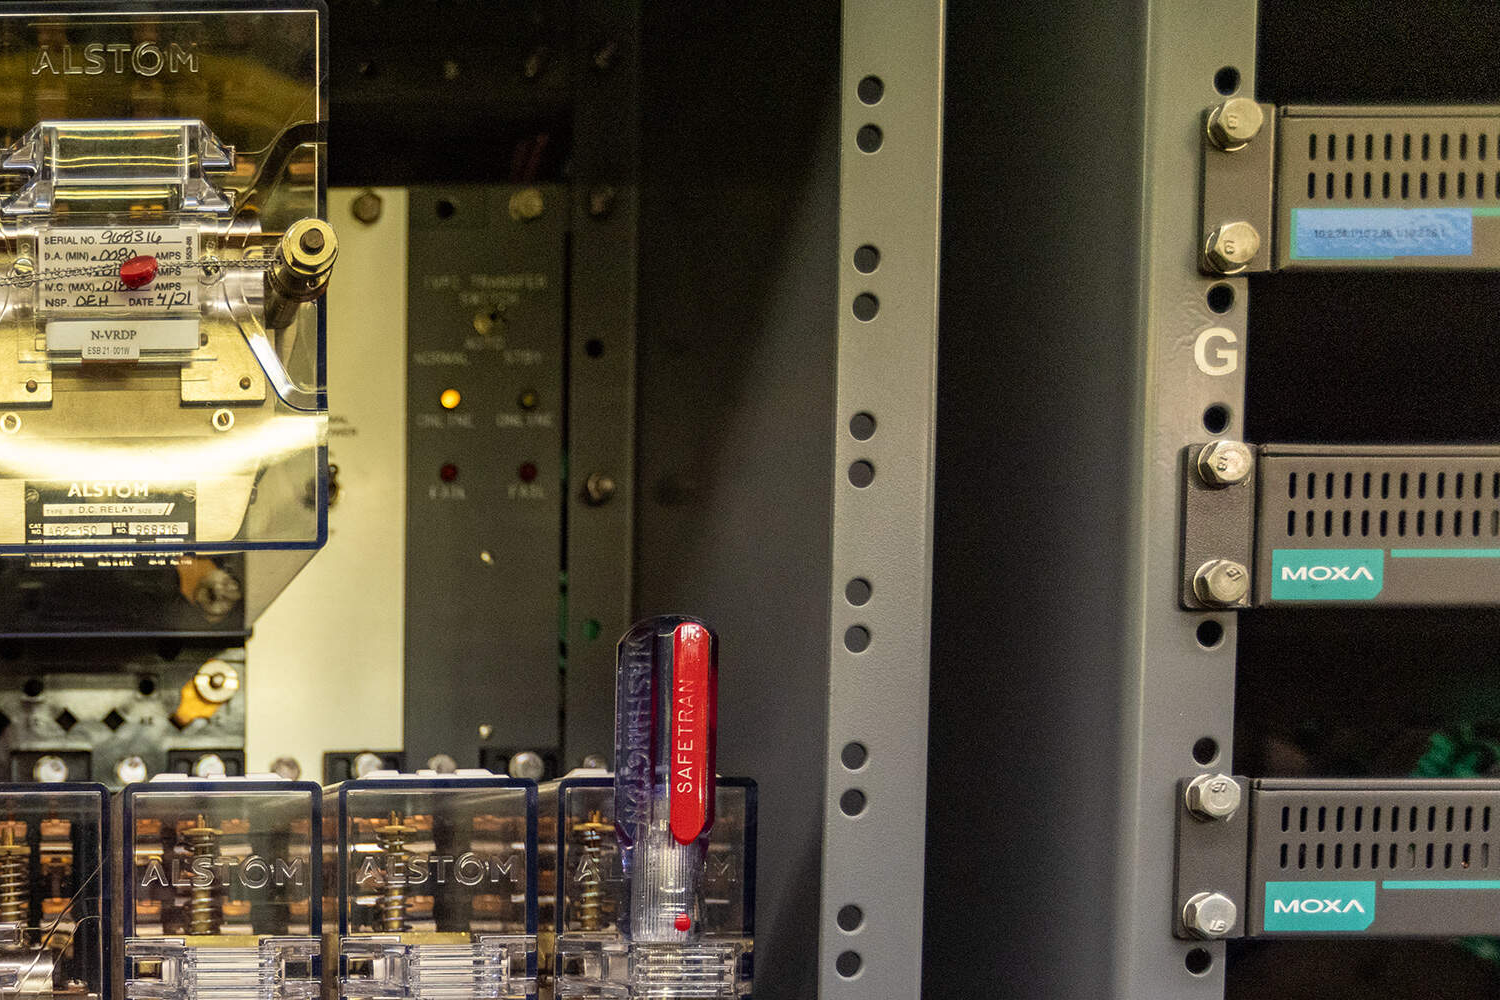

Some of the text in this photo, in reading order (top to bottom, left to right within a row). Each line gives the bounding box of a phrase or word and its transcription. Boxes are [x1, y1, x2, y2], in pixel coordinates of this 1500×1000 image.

[30, 41, 200, 78] ALSTOM
[44, 230, 163, 245] SERIAL NO. 968316
[65, 252, 89, 261] (MIN)
[154, 251, 181, 260] AMPS
[154, 282, 181, 291] AMPS
[128, 298, 154, 307] DATE
[91, 330, 137, 340] N-VRDP
[1194, 327, 1239, 376] G
[67, 482, 149, 498] ALSTOM
[100, 506, 135, 514] RELAY
[1281, 566, 1373, 581] MOXA
[676, 679, 695, 794] SAFETRAN
[139, 853, 305, 890] ALSTOM
[355, 851, 520, 887] ALSTOM
[1273, 898, 1365, 914] MOXA
